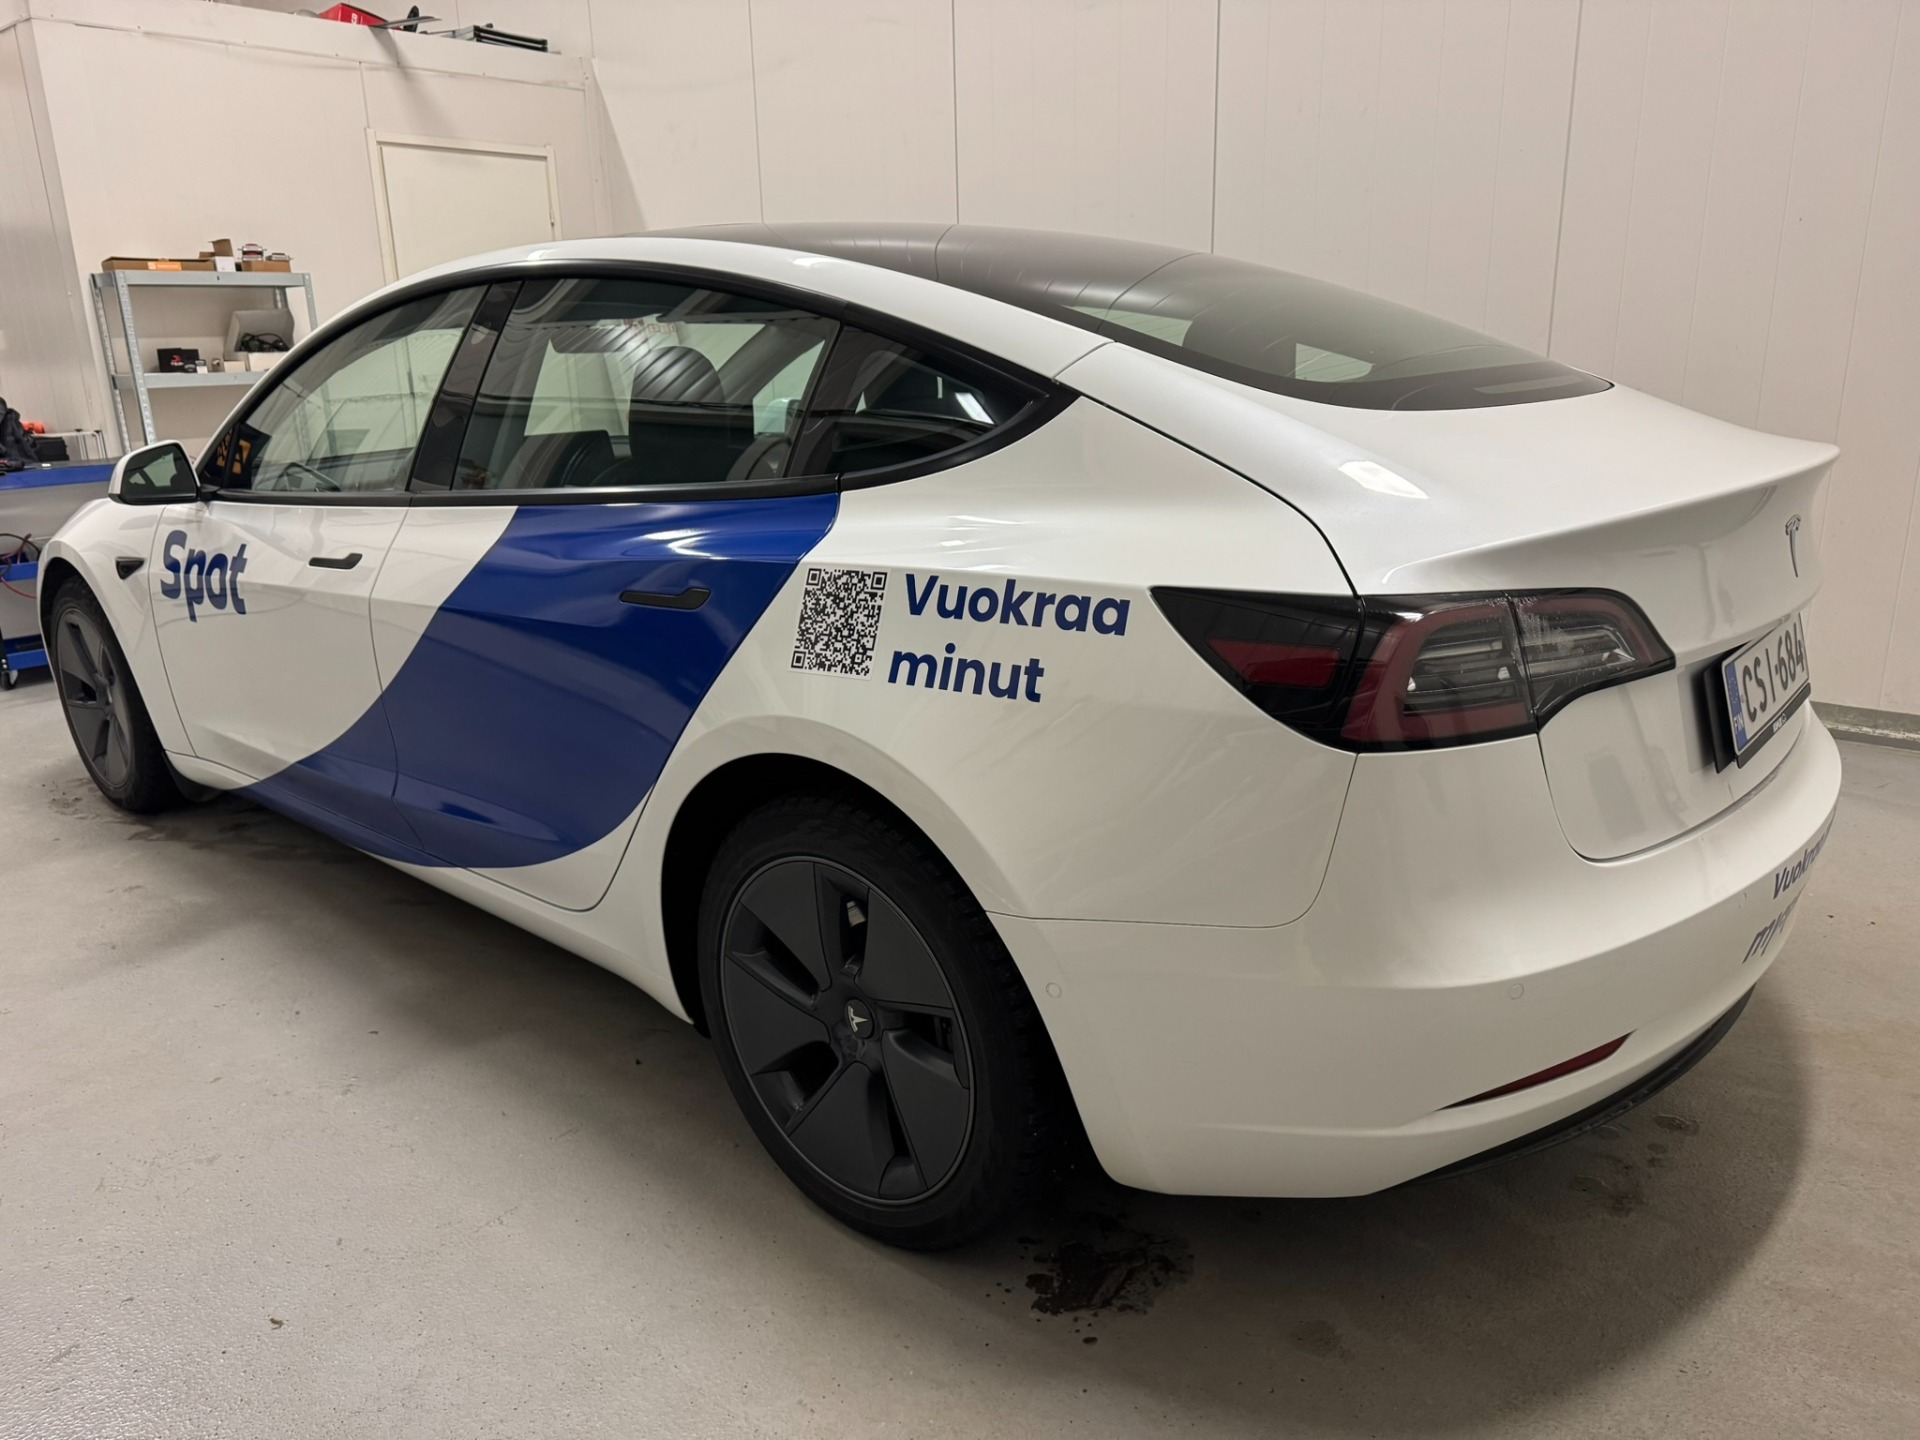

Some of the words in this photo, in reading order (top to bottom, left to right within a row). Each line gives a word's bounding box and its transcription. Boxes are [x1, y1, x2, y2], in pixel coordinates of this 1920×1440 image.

[160, 530, 247, 622] Spot
[905, 573, 1131, 636] Vuokraa
[888, 642, 1044, 702] minut
[1743, 622, 1805, 722] CSI-684
